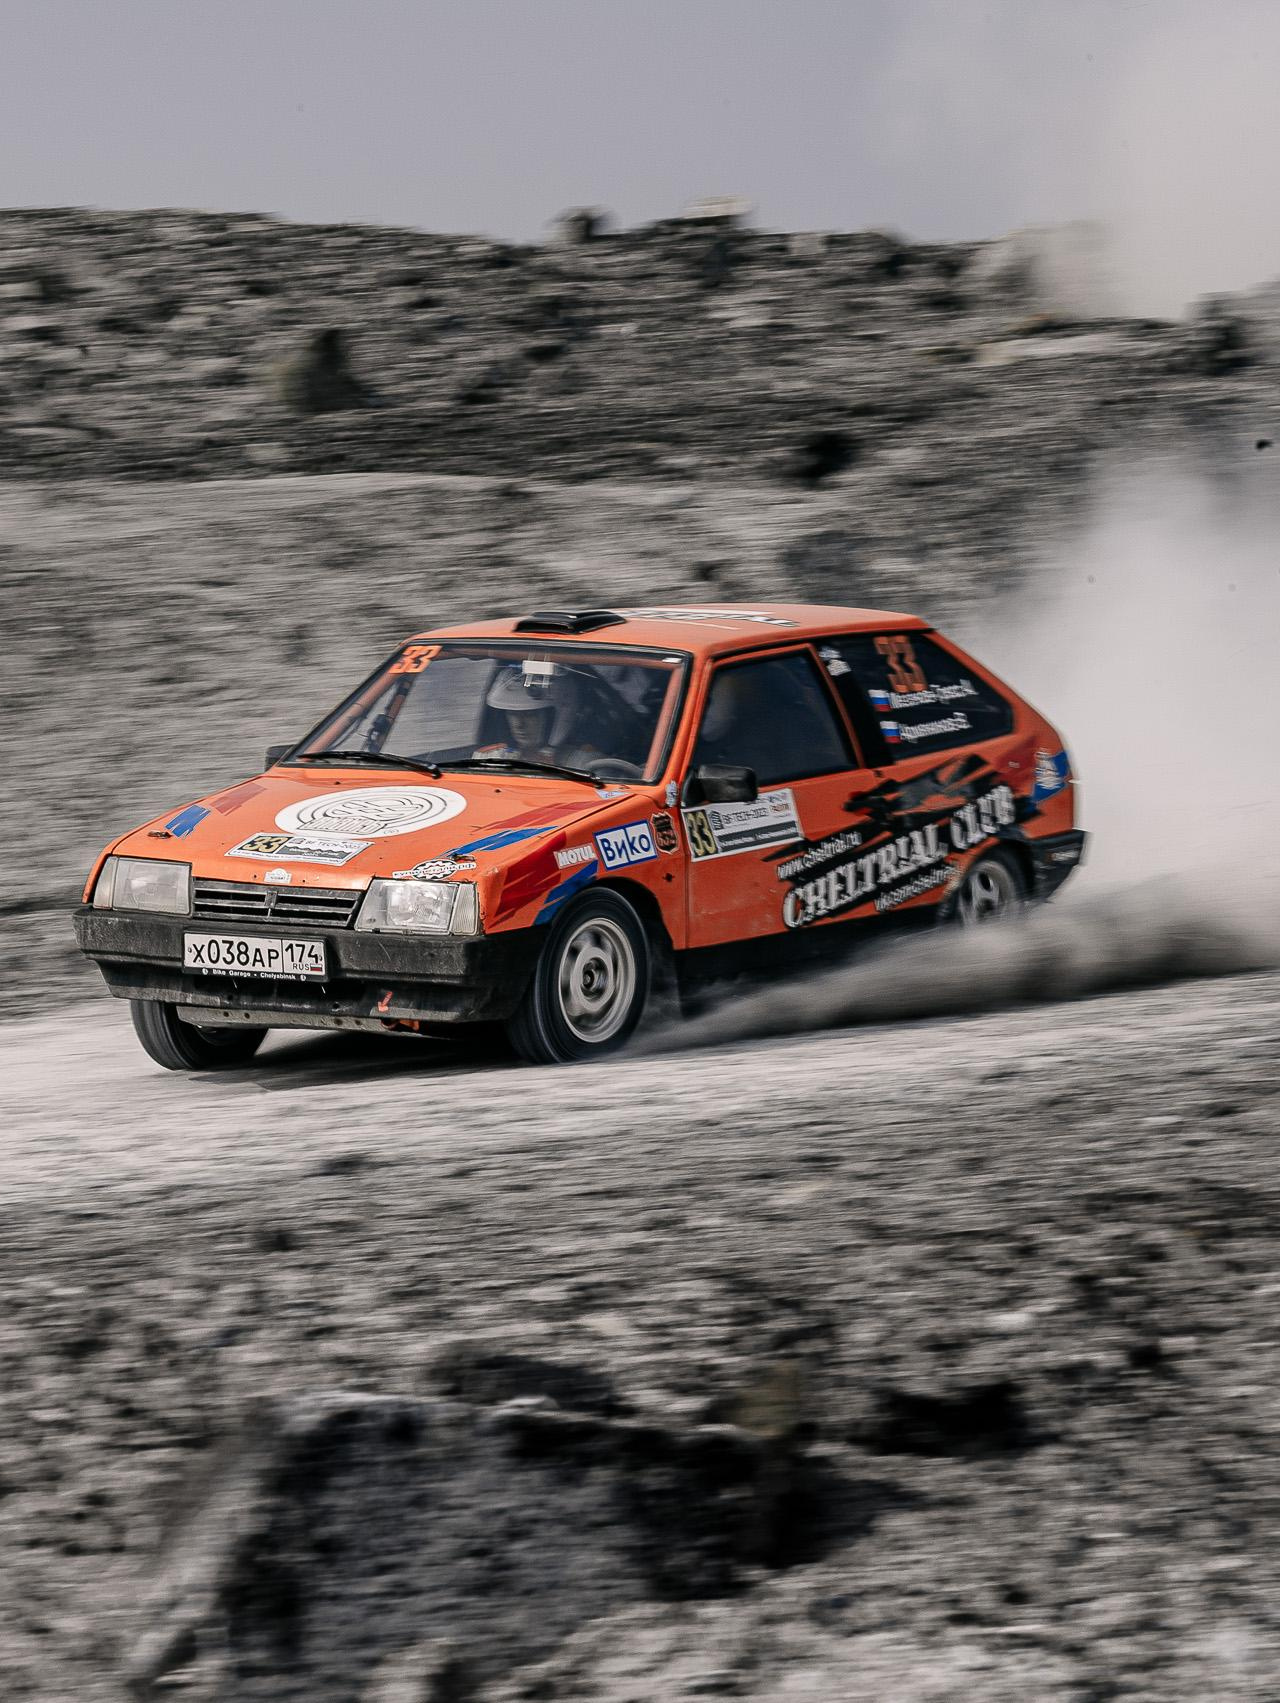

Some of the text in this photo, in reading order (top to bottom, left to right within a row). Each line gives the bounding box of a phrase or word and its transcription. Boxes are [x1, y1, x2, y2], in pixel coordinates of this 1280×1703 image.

[388, 645, 442, 673] 33
[874, 635, 928, 693] 33
[241, 836, 289, 853] 33
[687, 811, 717, 857] 33
[558, 846, 595, 866] MOTUL
[783, 785, 1015, 928] CHELTRIAL CLUB
[192, 939, 319, 968] Х038АР 174
[292, 963, 310, 971] RUS
[228, 970, 251, 978] Garage
